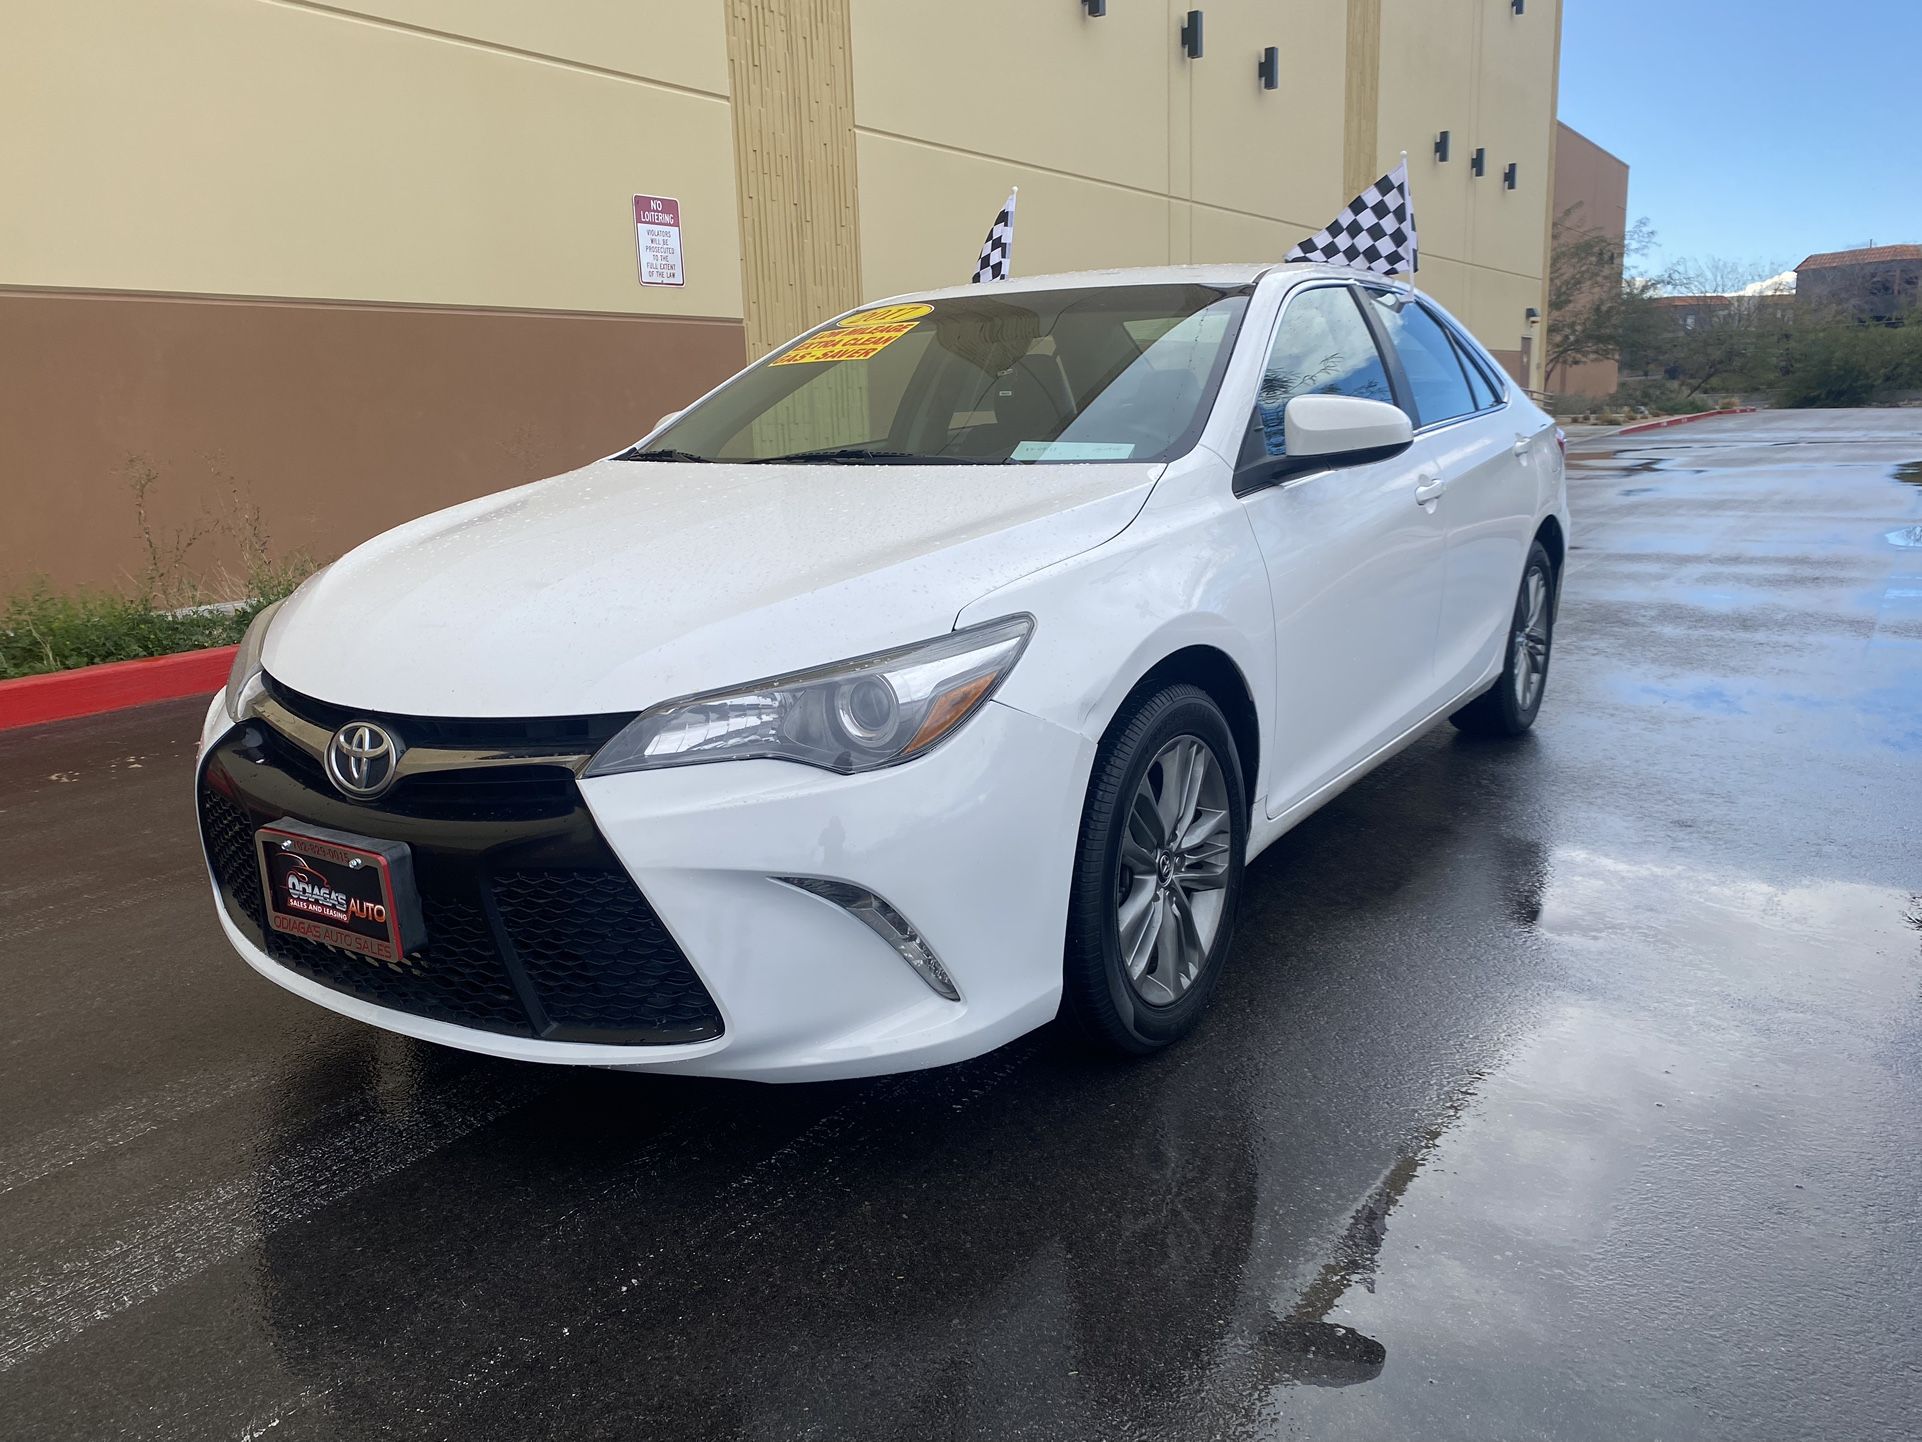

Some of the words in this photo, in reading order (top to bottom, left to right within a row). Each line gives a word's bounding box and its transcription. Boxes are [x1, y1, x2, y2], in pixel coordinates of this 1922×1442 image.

[650, 200, 662, 210] NO
[641, 211, 674, 224] LOITERING
[647, 230, 672, 238] VIOLATORS
[646, 246, 674, 254] PROSECUTED
[646, 262, 658, 270] FULL
[793, 339, 844, 352] EXTRA
[842, 335, 898, 346] CLEAN
[814, 348, 878, 360] SAVER
[290, 898, 308, 909] SALES
[308, 903, 322, 912] AND
[324, 908, 348, 920] LEASING
[348, 898, 386, 922] AUTO
[324, 930, 352, 947] AUTO
[354, 936, 392, 960] SALES
